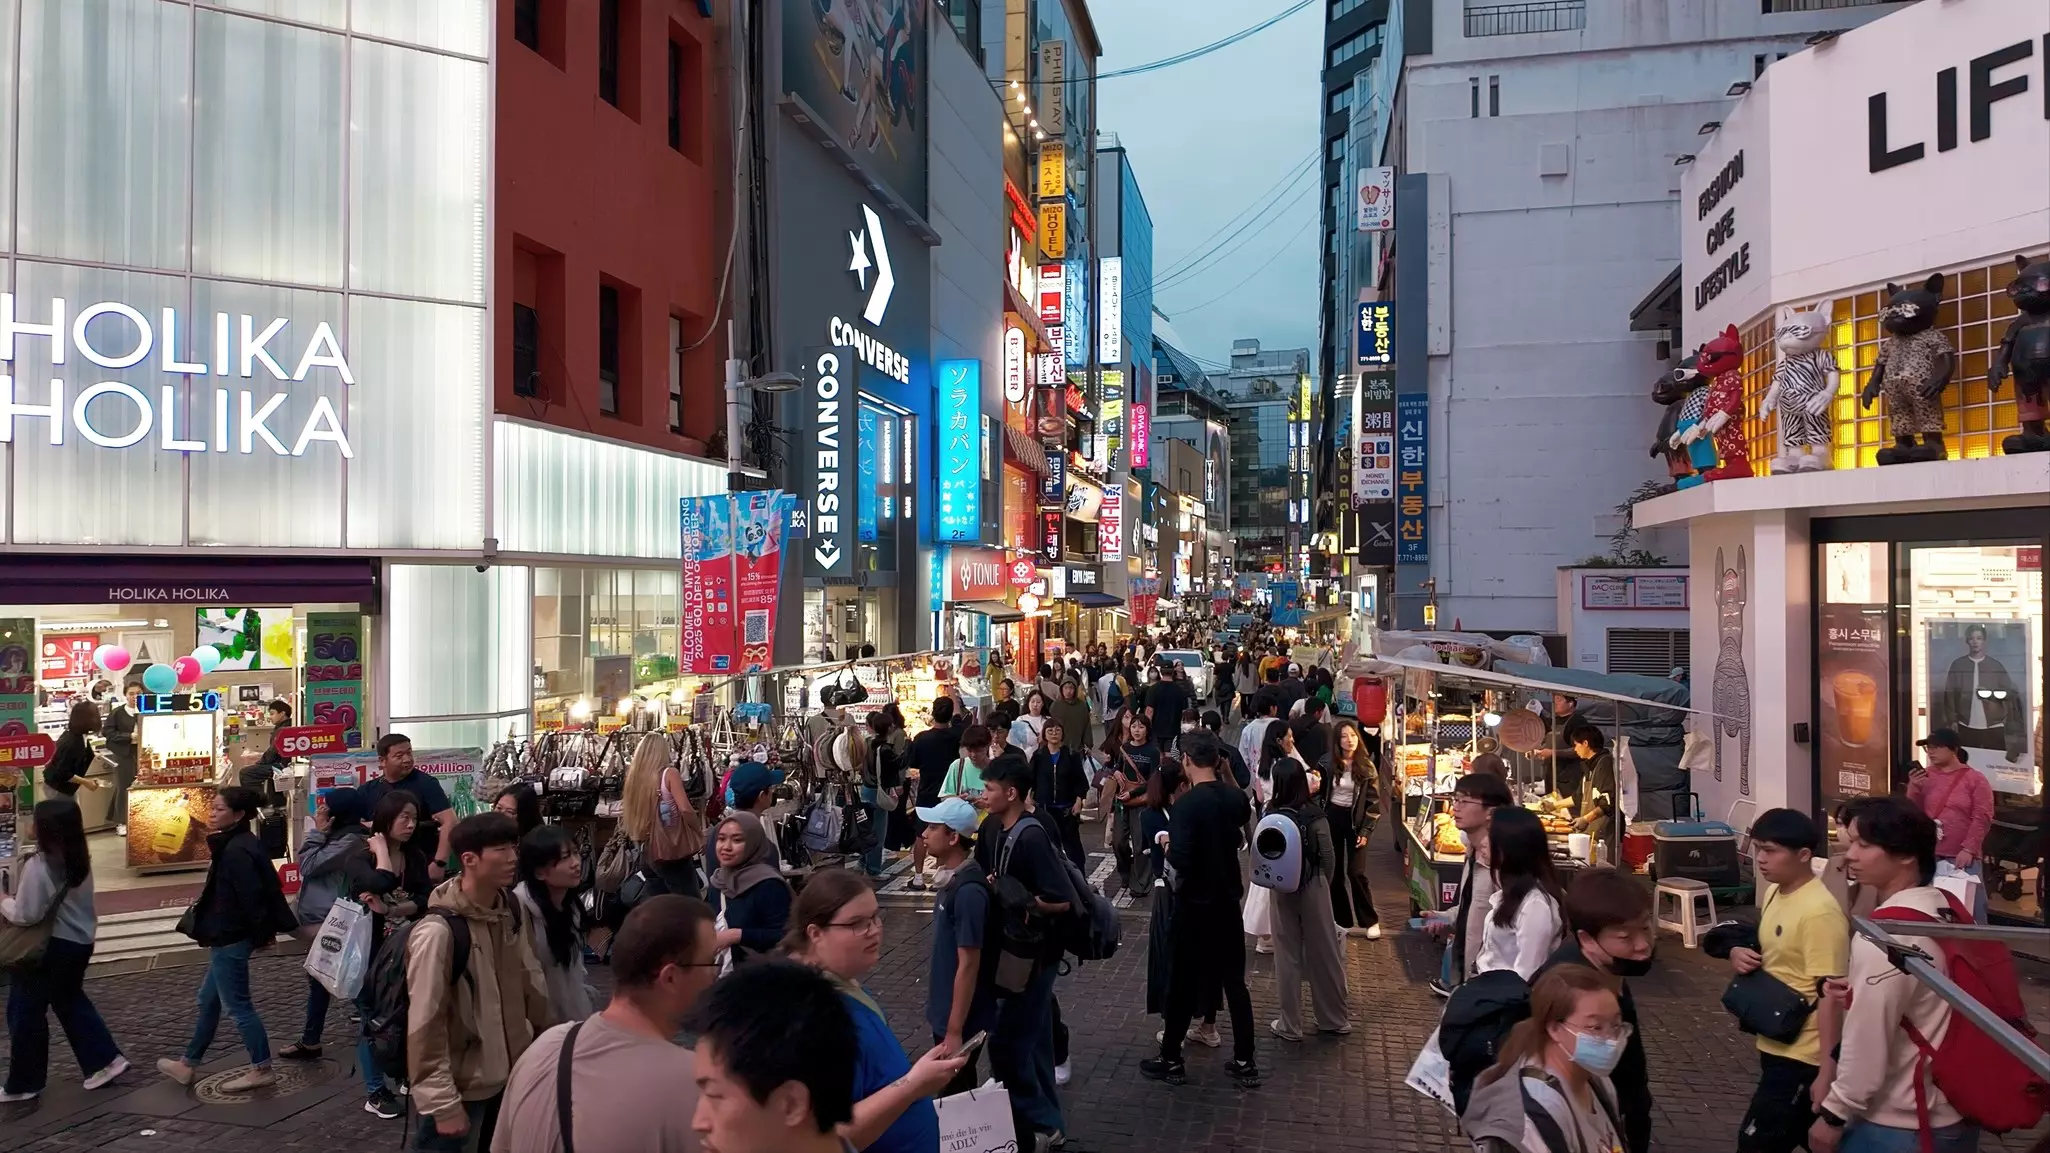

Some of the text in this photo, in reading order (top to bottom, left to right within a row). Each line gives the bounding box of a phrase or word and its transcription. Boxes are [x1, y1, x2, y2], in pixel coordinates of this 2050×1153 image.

[1869, 33, 2050, 174] LIF
[1044, 154, 1052, 190] エステ
[1698, 149, 1744, 221] FASHION
[1381, 171, 1391, 216] マッサージ
[1042, 206, 1063, 214] MIZO
[1047, 214, 1058, 252] HOTEL
[1706, 207, 1735, 255] CAFE
[1695, 242, 1750, 311] LIFESTYLE
[1361, 307, 1373, 332] 신한
[1373, 306, 1390, 354] 부동산
[0, 293, 355, 385] HOLIKA
[830, 316, 909, 385] CONVERSE
[1050, 328, 1063, 382] 부동산
[1112, 349, 1118, 358] 2
[1364, 390, 1394, 400] 비빔밥
[1369, 379, 1390, 390] 본죽
[0, 375, 354, 458] HOLIKA
[950, 367, 970, 474] ソラカバン
[817, 353, 840, 534] CONVERSE
[1401, 420, 1425, 540] 신한부동산
[952, 530, 965, 539] 2F
[1047, 523, 1058, 558] 노래방
[1100, 497, 1120, 552] 부동산
[682, 498, 694, 673] WELCOME TO MYEONGDONG
[690, 511, 704, 659] 2025 GOLDEN OCTOBER
[972, 563, 1000, 586] TONUE
[109, 588, 229, 600] HOLIKA HOLIKA
[313, 633, 357, 662] 50
[1828, 628, 1848, 640] 홍시
[307, 664, 362, 682] SALE
[141, 692, 219, 712] LE 50
[314, 687, 356, 695] 브랜드데이
[313, 702, 357, 731] 50
[14, 744, 44, 760] 세일
[312, 735, 336, 743] SALE
[312, 742, 328, 750] OFF
[949, 1136, 978, 1152] ADLV
[956, 1128, 967, 1139] de
[968, 1126, 977, 1135] la
